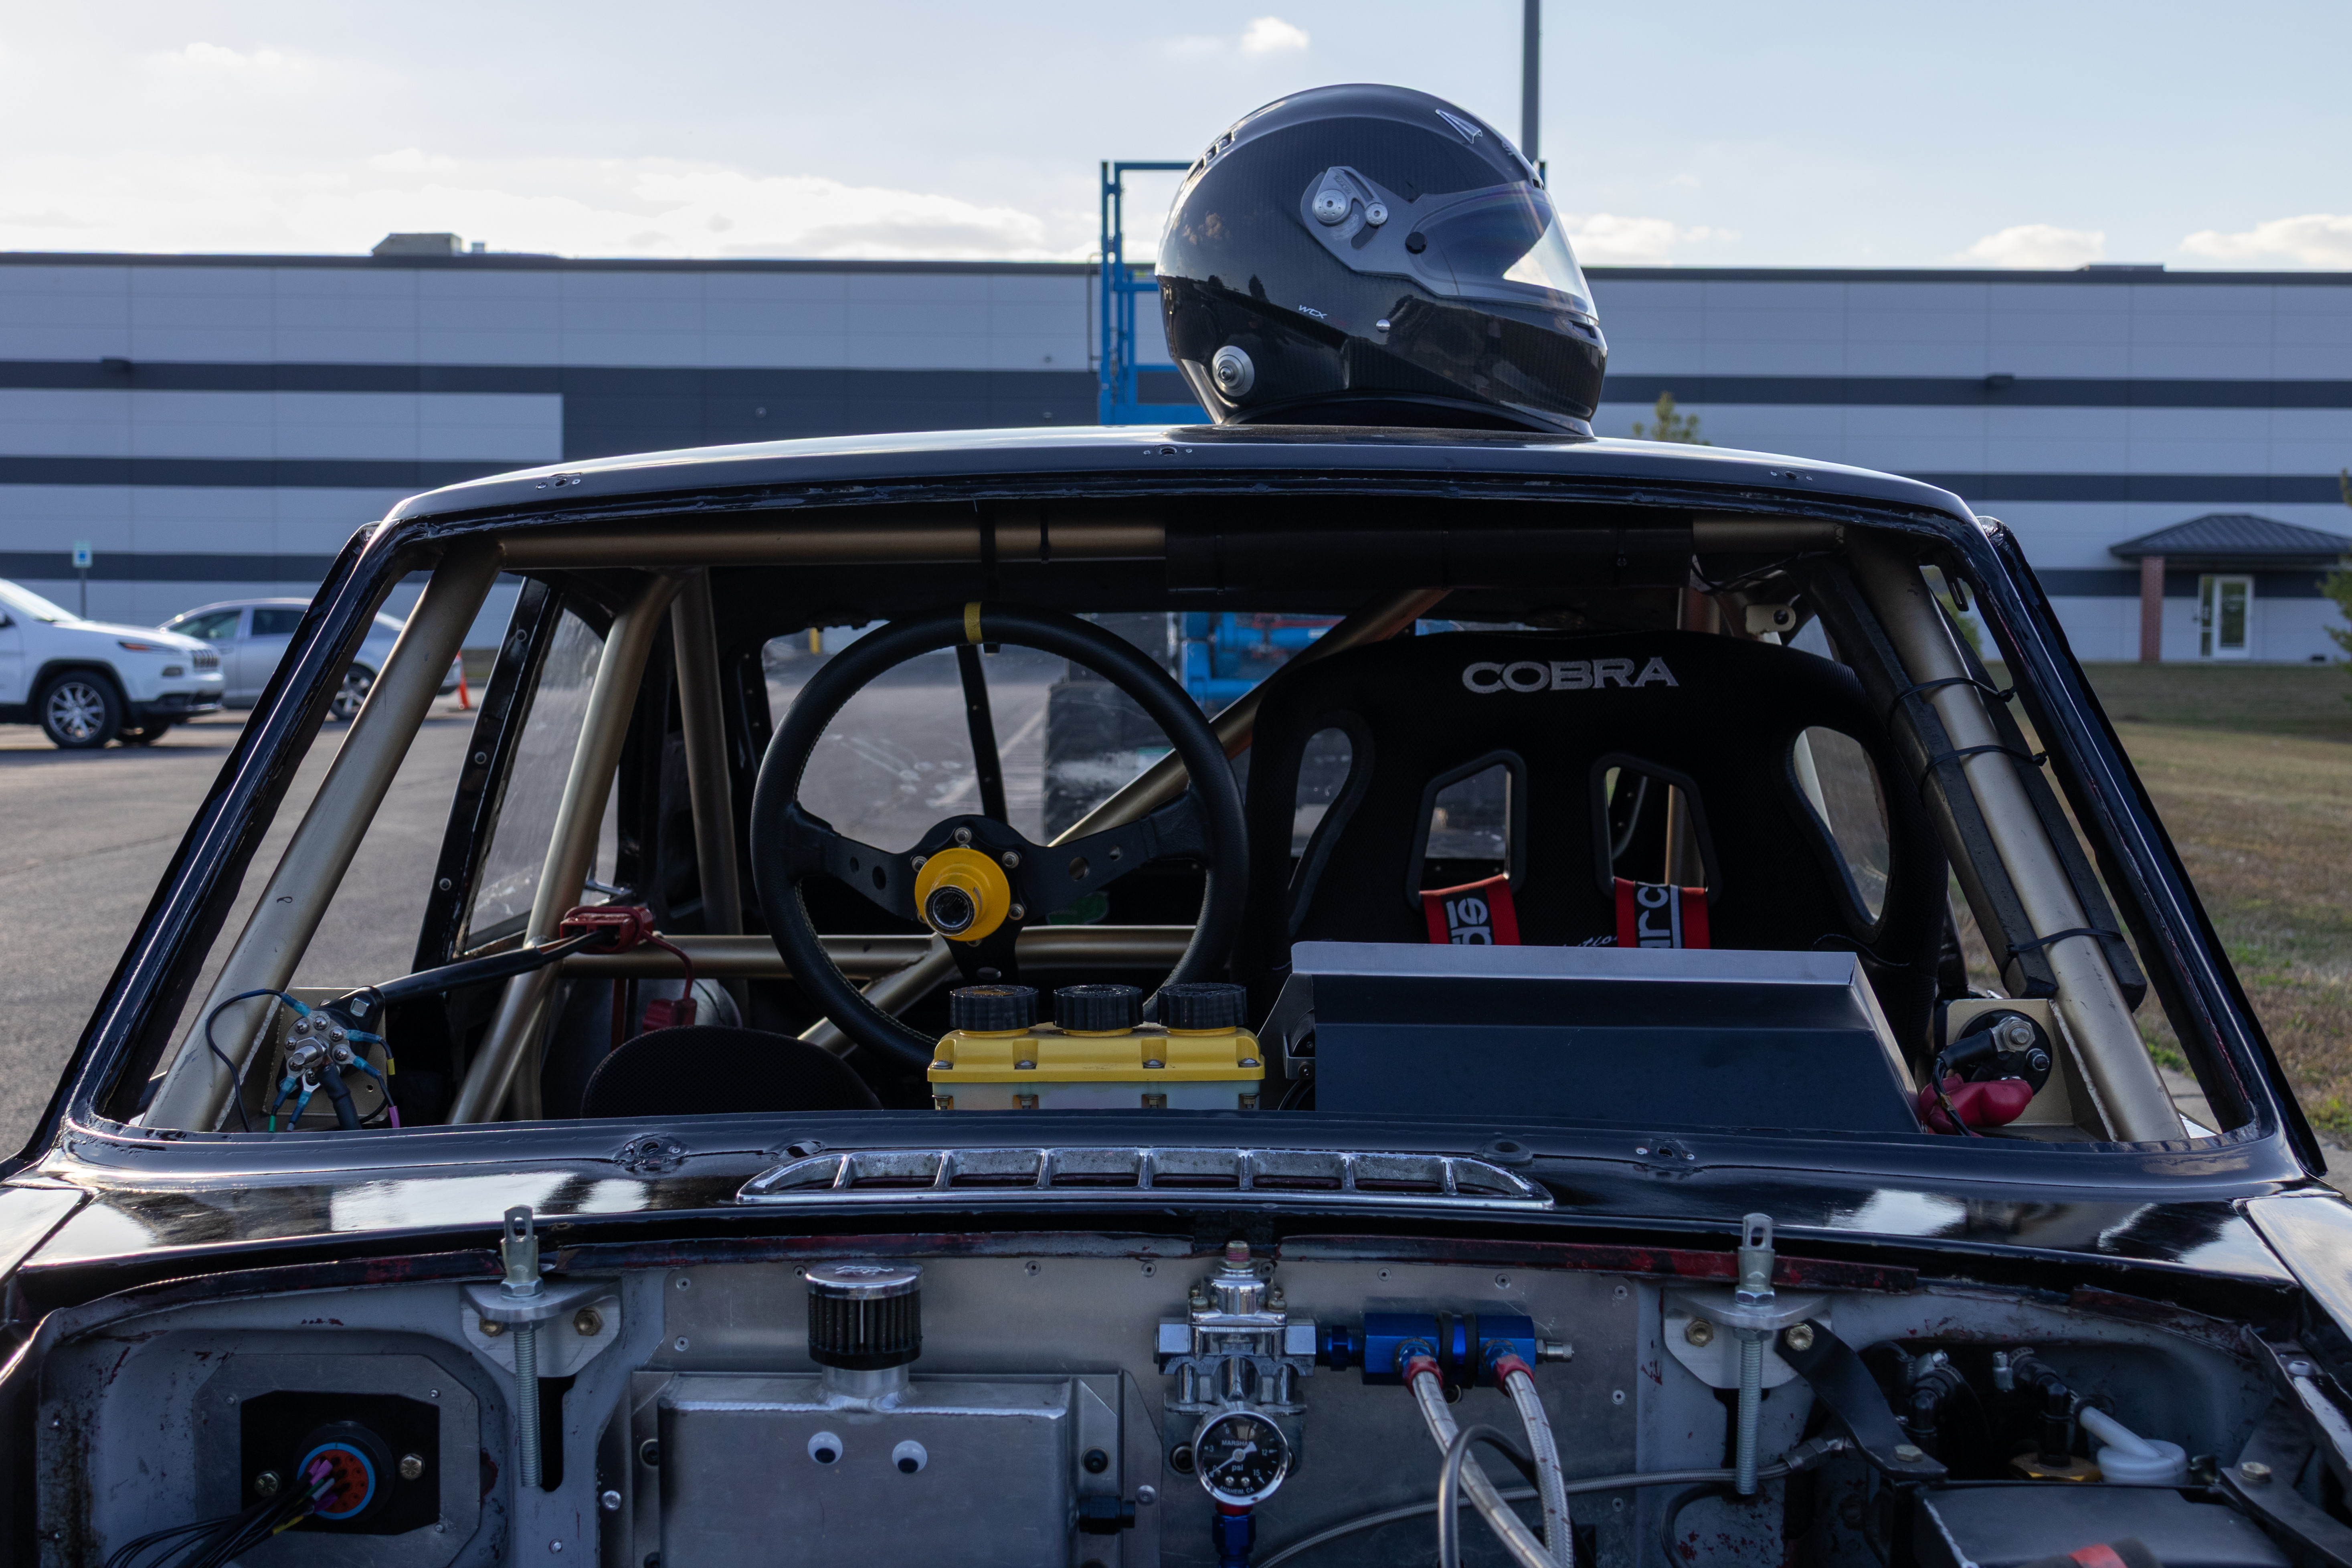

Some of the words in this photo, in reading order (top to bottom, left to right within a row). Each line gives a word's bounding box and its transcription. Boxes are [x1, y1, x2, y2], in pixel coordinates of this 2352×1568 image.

[1298, 305, 1327, 319] WCX
[1462, 656, 1680, 694] COBRA
[1219, 1485, 1246, 1495] ANAHEIM,
